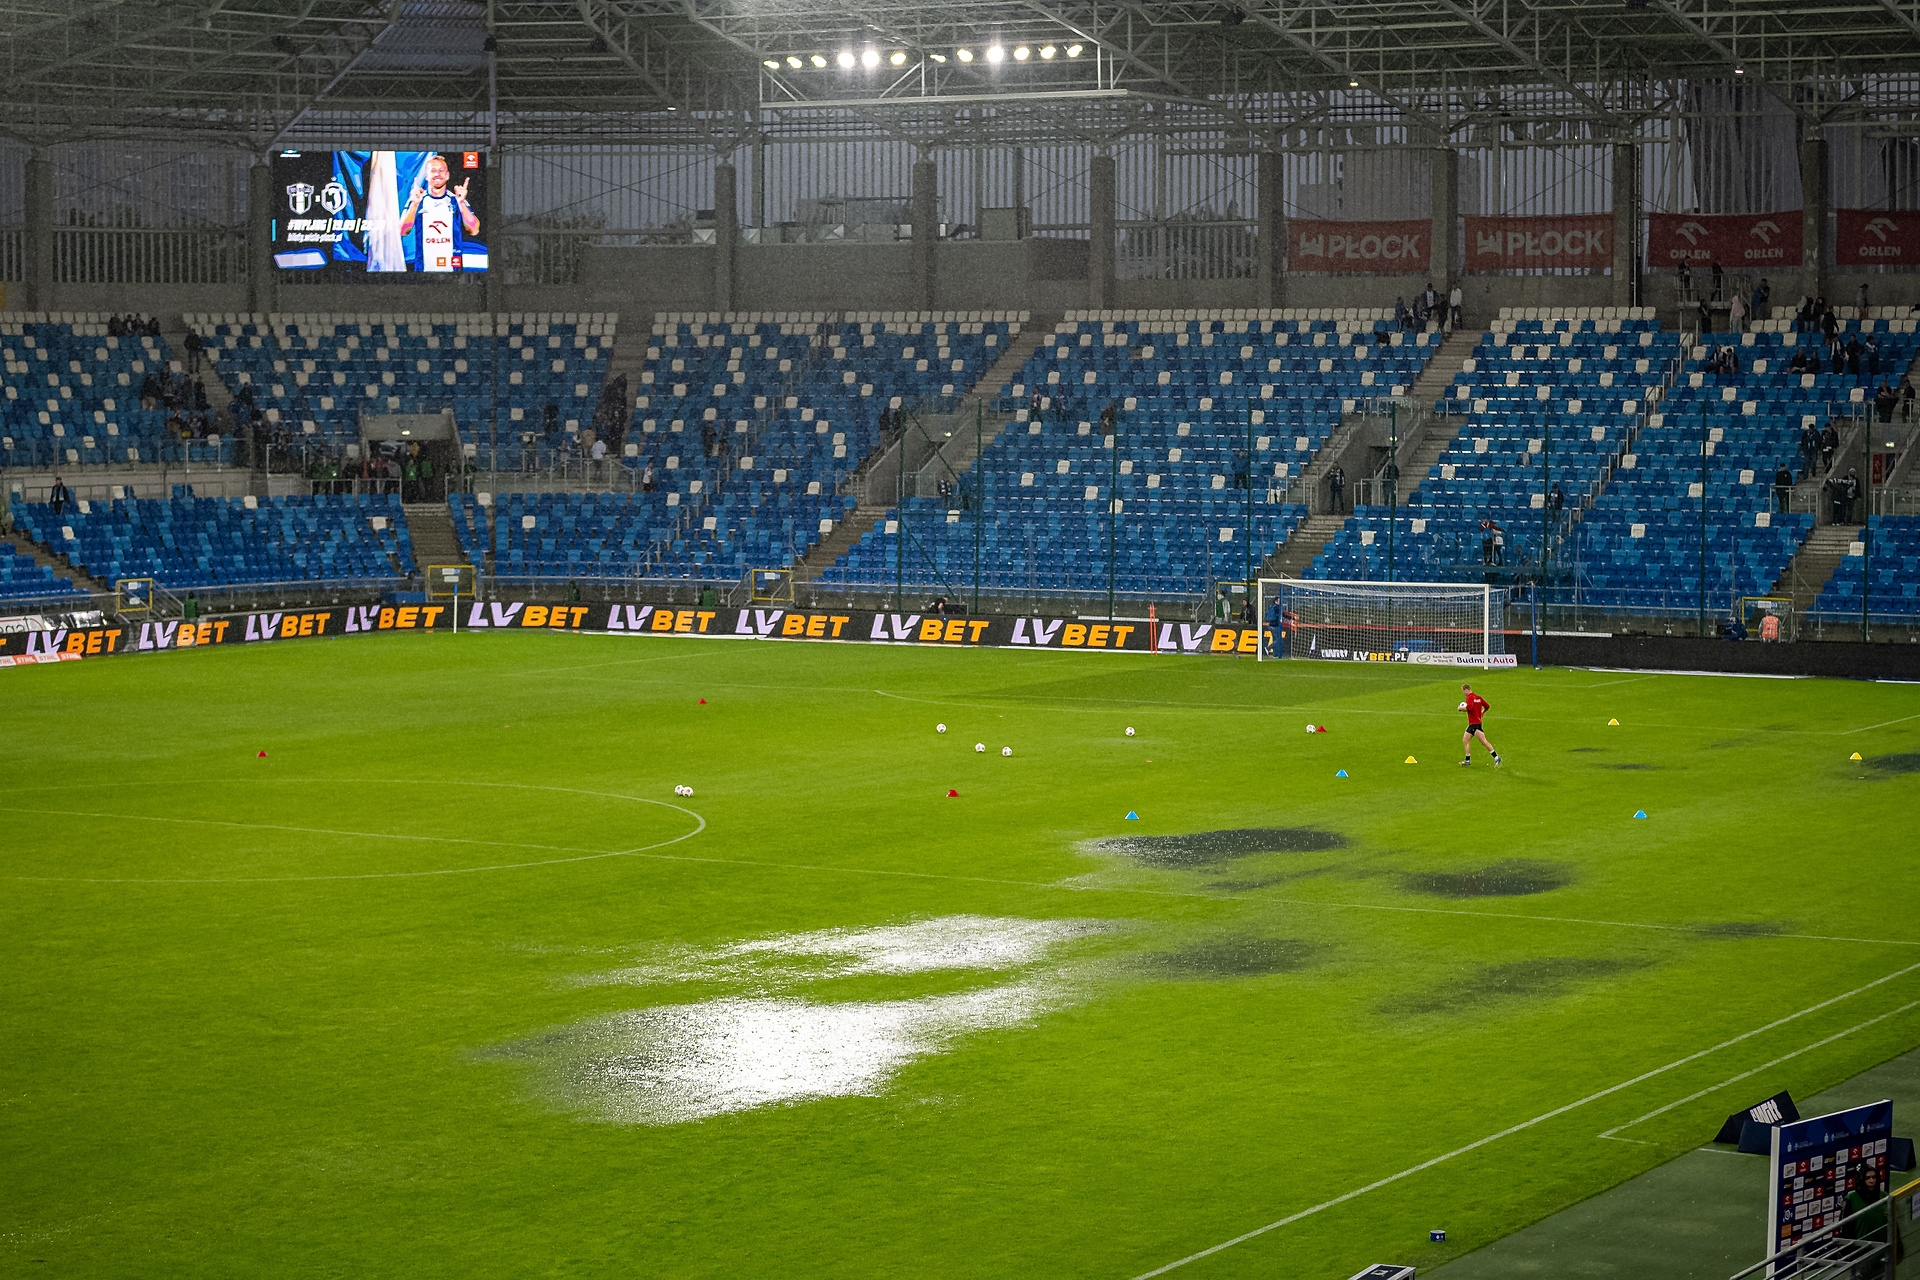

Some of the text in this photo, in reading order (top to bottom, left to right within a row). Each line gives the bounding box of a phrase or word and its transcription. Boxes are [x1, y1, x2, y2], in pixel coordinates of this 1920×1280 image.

[1328, 234, 1420, 260] PŁOCK
[1507, 230, 1605, 256] PŁOCK
[1669, 249, 1711, 260] ORLEN
[1744, 247, 1784, 259] ORLEN
[1858, 245, 1902, 257] ORLEN
[1353, 651, 1407, 661] LVBET.PL
[1493, 656, 1515, 664] Auto
